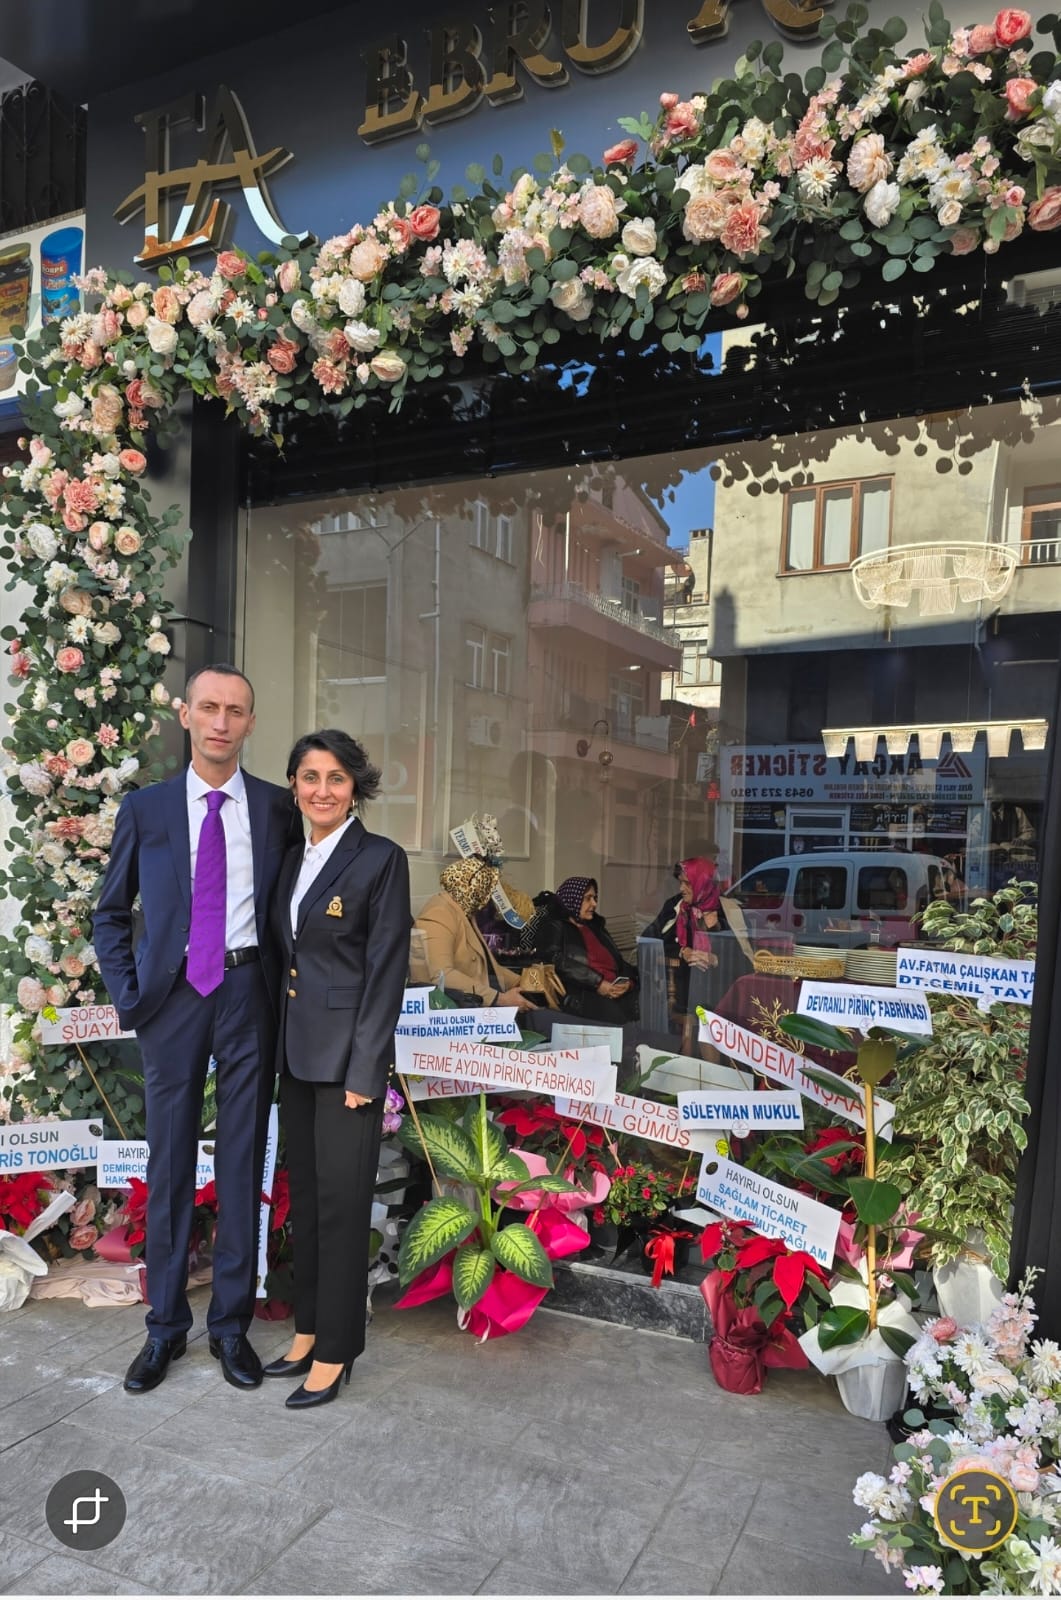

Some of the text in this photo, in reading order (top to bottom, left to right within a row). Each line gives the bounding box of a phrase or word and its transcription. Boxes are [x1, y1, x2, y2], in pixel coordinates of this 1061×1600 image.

[899, 958, 957, 975] AV.FATMA
[960, 965, 1018, 982] ÇALIŞKAN
[990, 986, 1032, 999] TAY
[806, 994, 928, 1020] DEVRANLI PİRİNÇ FABRİKASI
[62, 1019, 123, 1043] ŞUAYİ
[450, 1016, 475, 1024] OLSUN
[477, 1023, 516, 1035] ÖZTELCİ
[450, 1041, 504, 1060] HAYIRLI
[509, 1049, 557, 1067] OLSUN
[709, 1019, 795, 1080] GÜNDEM
[412, 1053, 595, 1097] TERME AYDIN PİRİNÇ FABRİKASI
[568, 1098, 691, 1148] HALİL GÜMÜŞ
[682, 1101, 800, 1120] SÜLEYMAN MUKUL
[9, 1131, 59, 1146] OLSUN
[28, 1144, 97, 1165] TONOĞLU
[726, 1168, 799, 1213] HAYIRLI OLSUN
[699, 1187, 730, 1210] DİLEK
[734, 1205, 777, 1235] MAHMUT
[718, 1183, 807, 1234] SAĞLAM TİCARET
